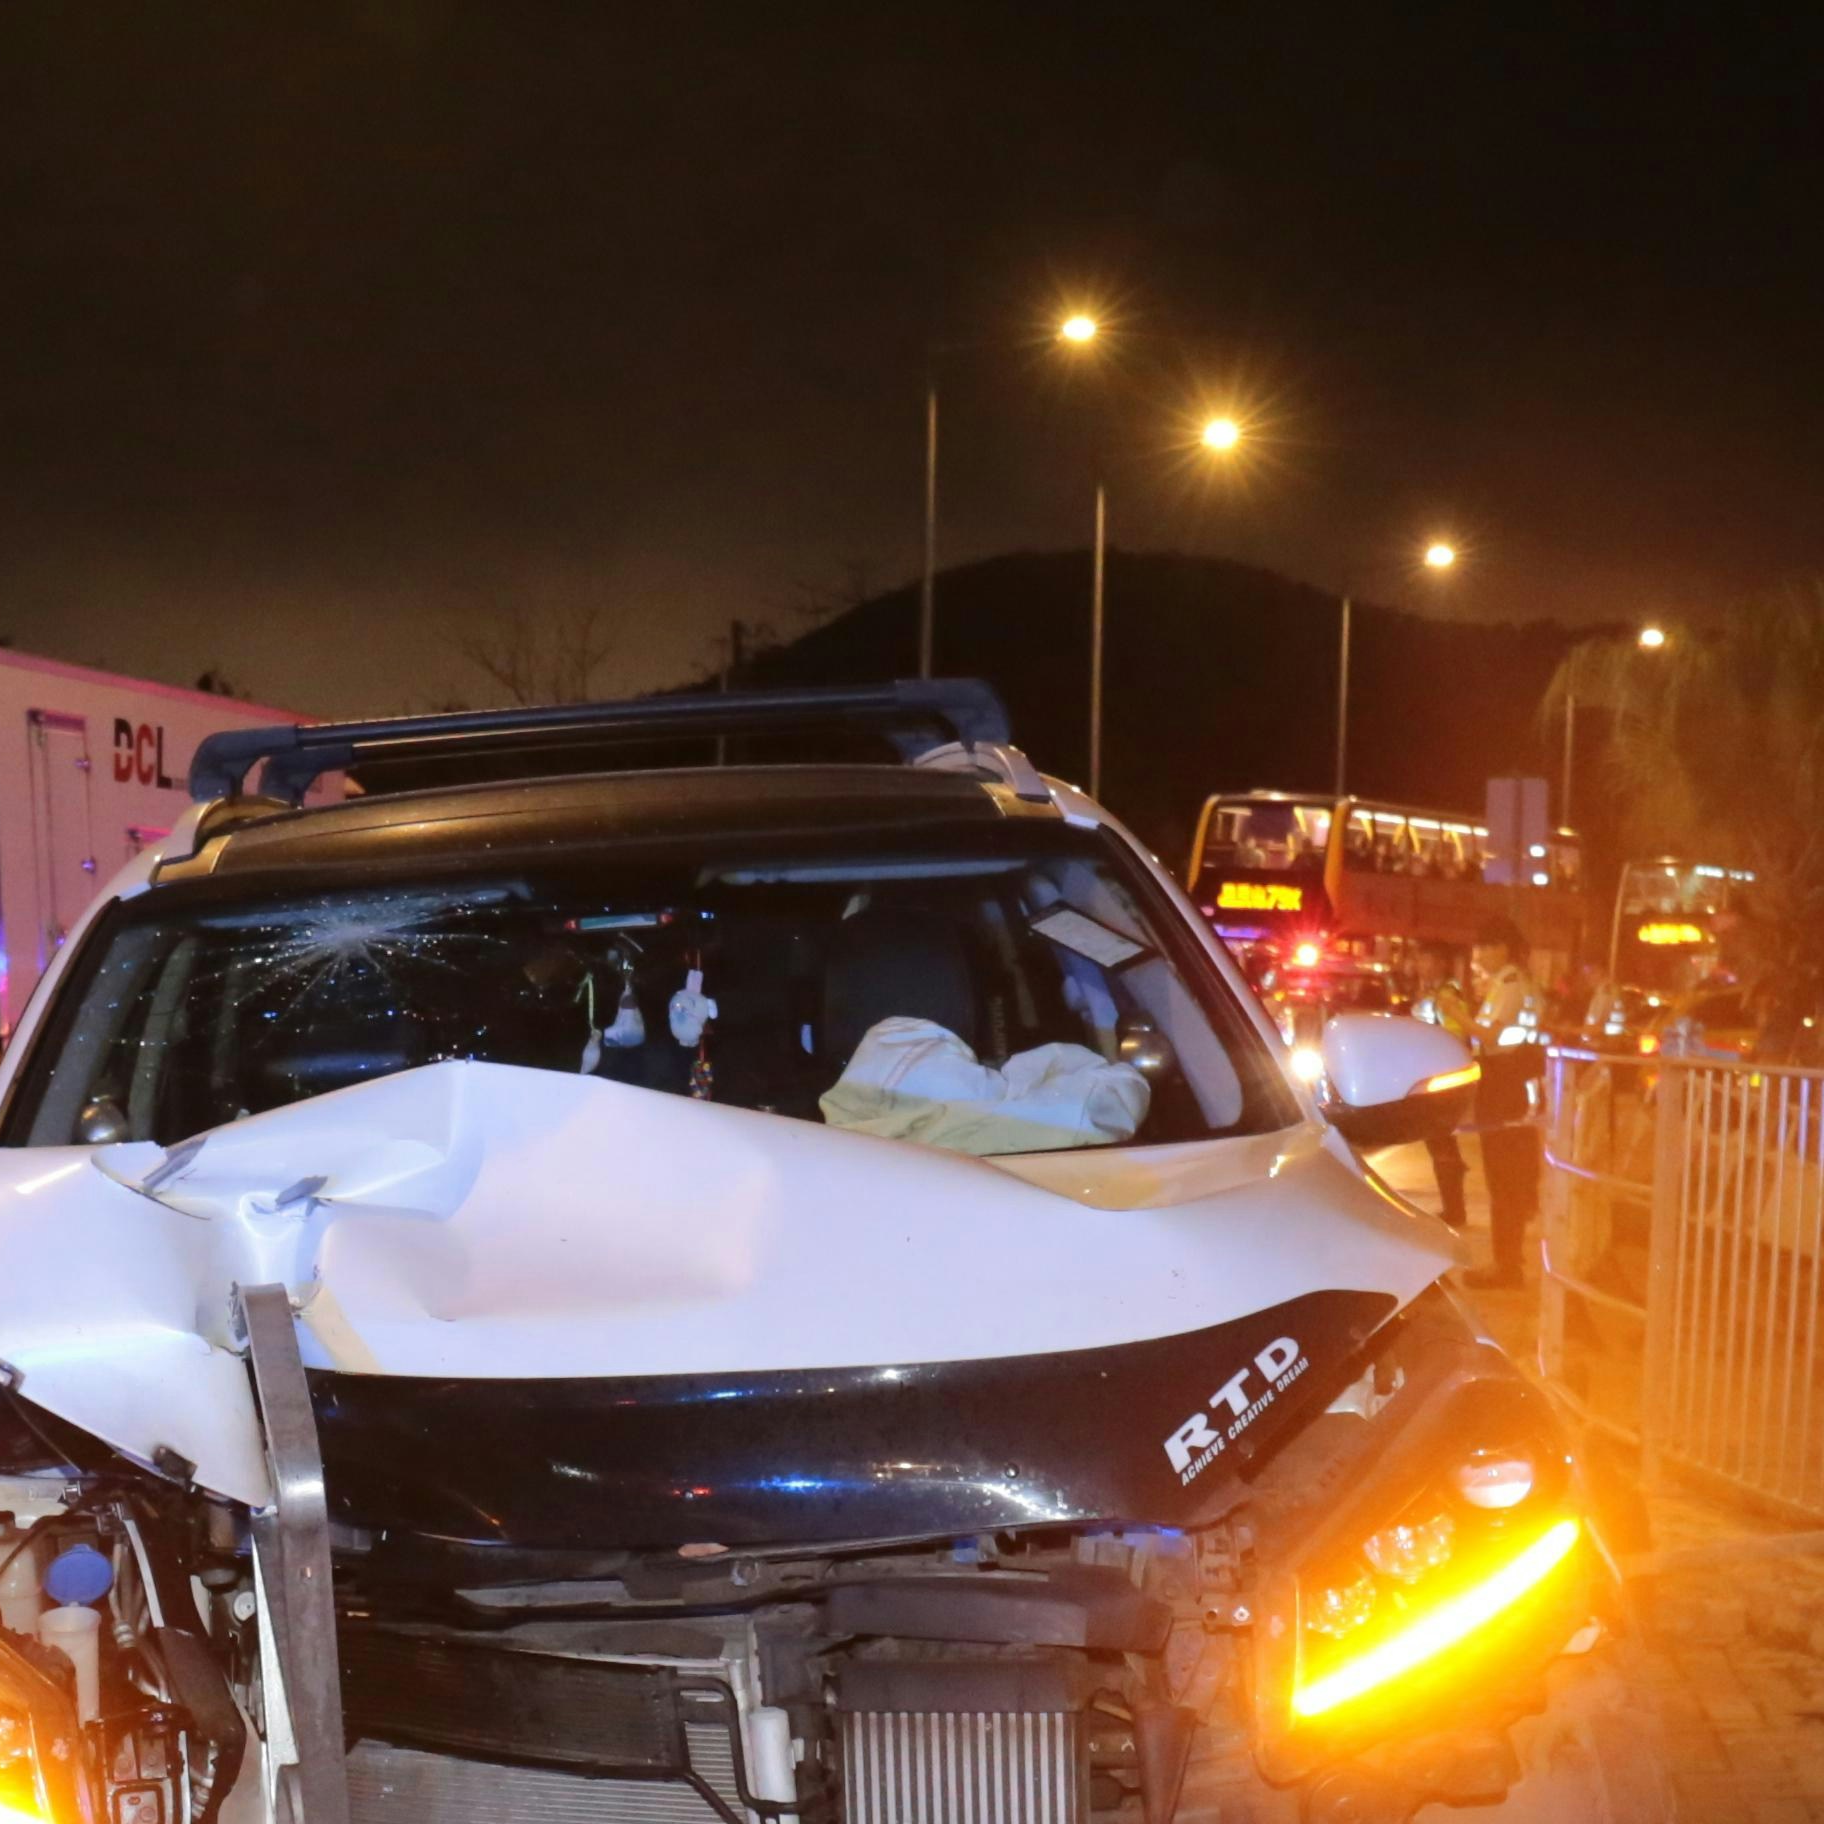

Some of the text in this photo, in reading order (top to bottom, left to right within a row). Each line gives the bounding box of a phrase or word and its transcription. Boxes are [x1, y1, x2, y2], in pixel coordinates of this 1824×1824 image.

[114, 718, 172, 789] DCL
[1163, 1336, 1300, 1474] RTD
[1180, 1356, 1310, 1487] ACHIEVE CREATIVE DREAM
